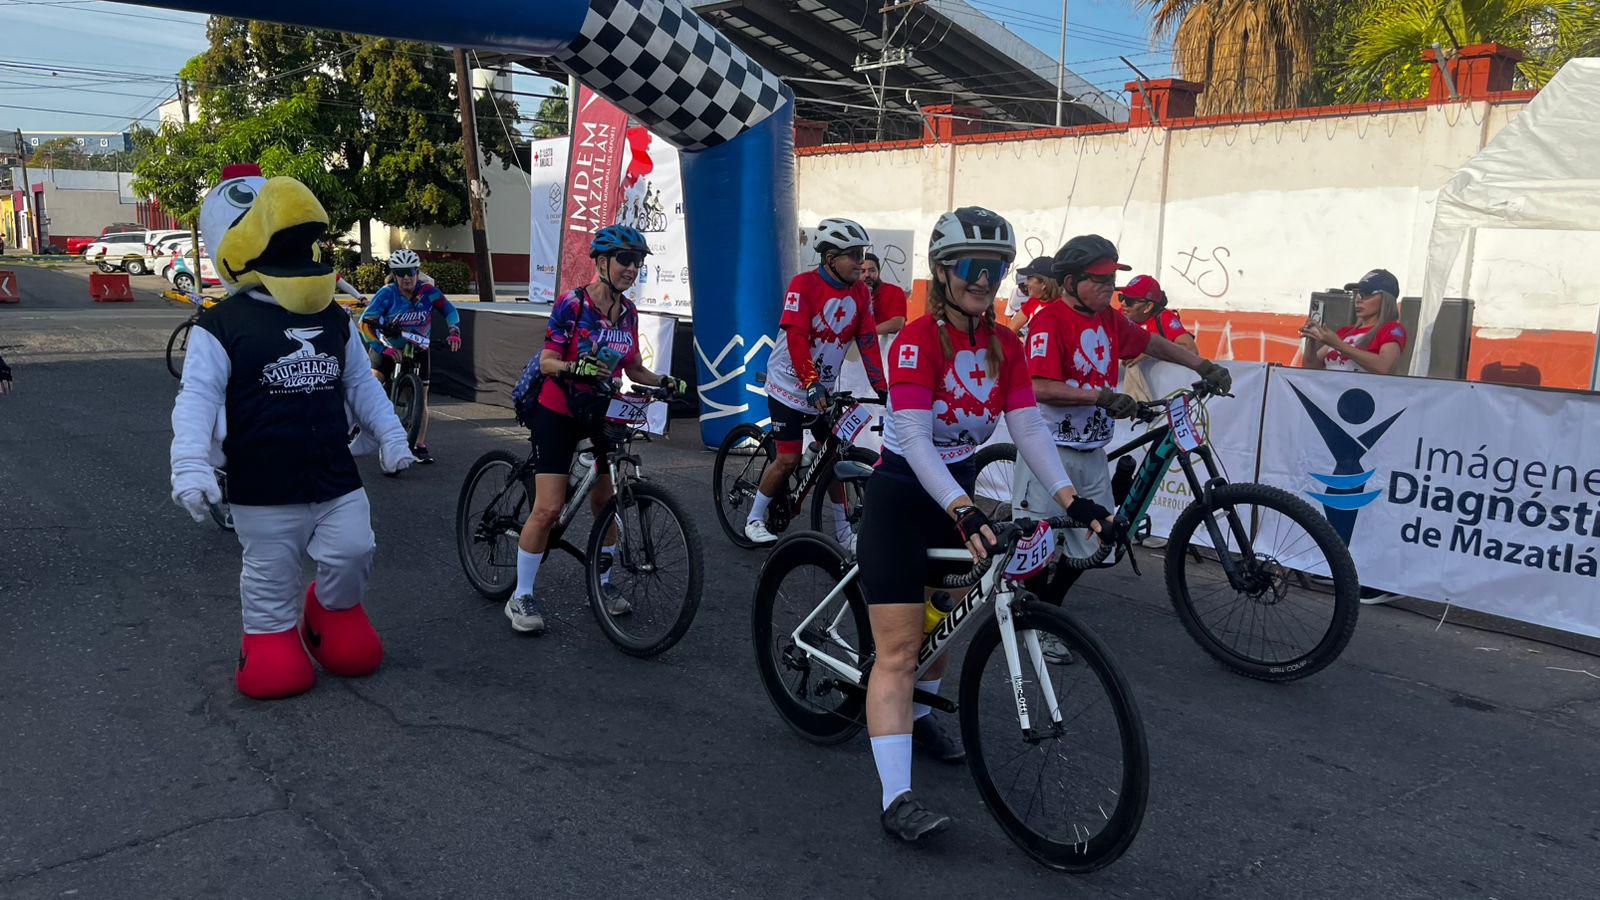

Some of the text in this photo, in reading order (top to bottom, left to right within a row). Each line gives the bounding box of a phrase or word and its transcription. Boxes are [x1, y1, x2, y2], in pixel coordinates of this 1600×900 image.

[570, 121, 597, 232] IMDEM
[589, 122, 611, 234] MAZATLÁN
[597, 328, 633, 347] FRIDAS
[264, 361, 340, 383] MUCHACHO
[1414, 437, 1600, 497] Imágene
[1016, 539, 1048, 571] 256
[1400, 517, 1599, 578] de Mazatlá
[916, 579, 985, 669] ERIDA
[1015, 676, 1029, 714] Muc-Off
